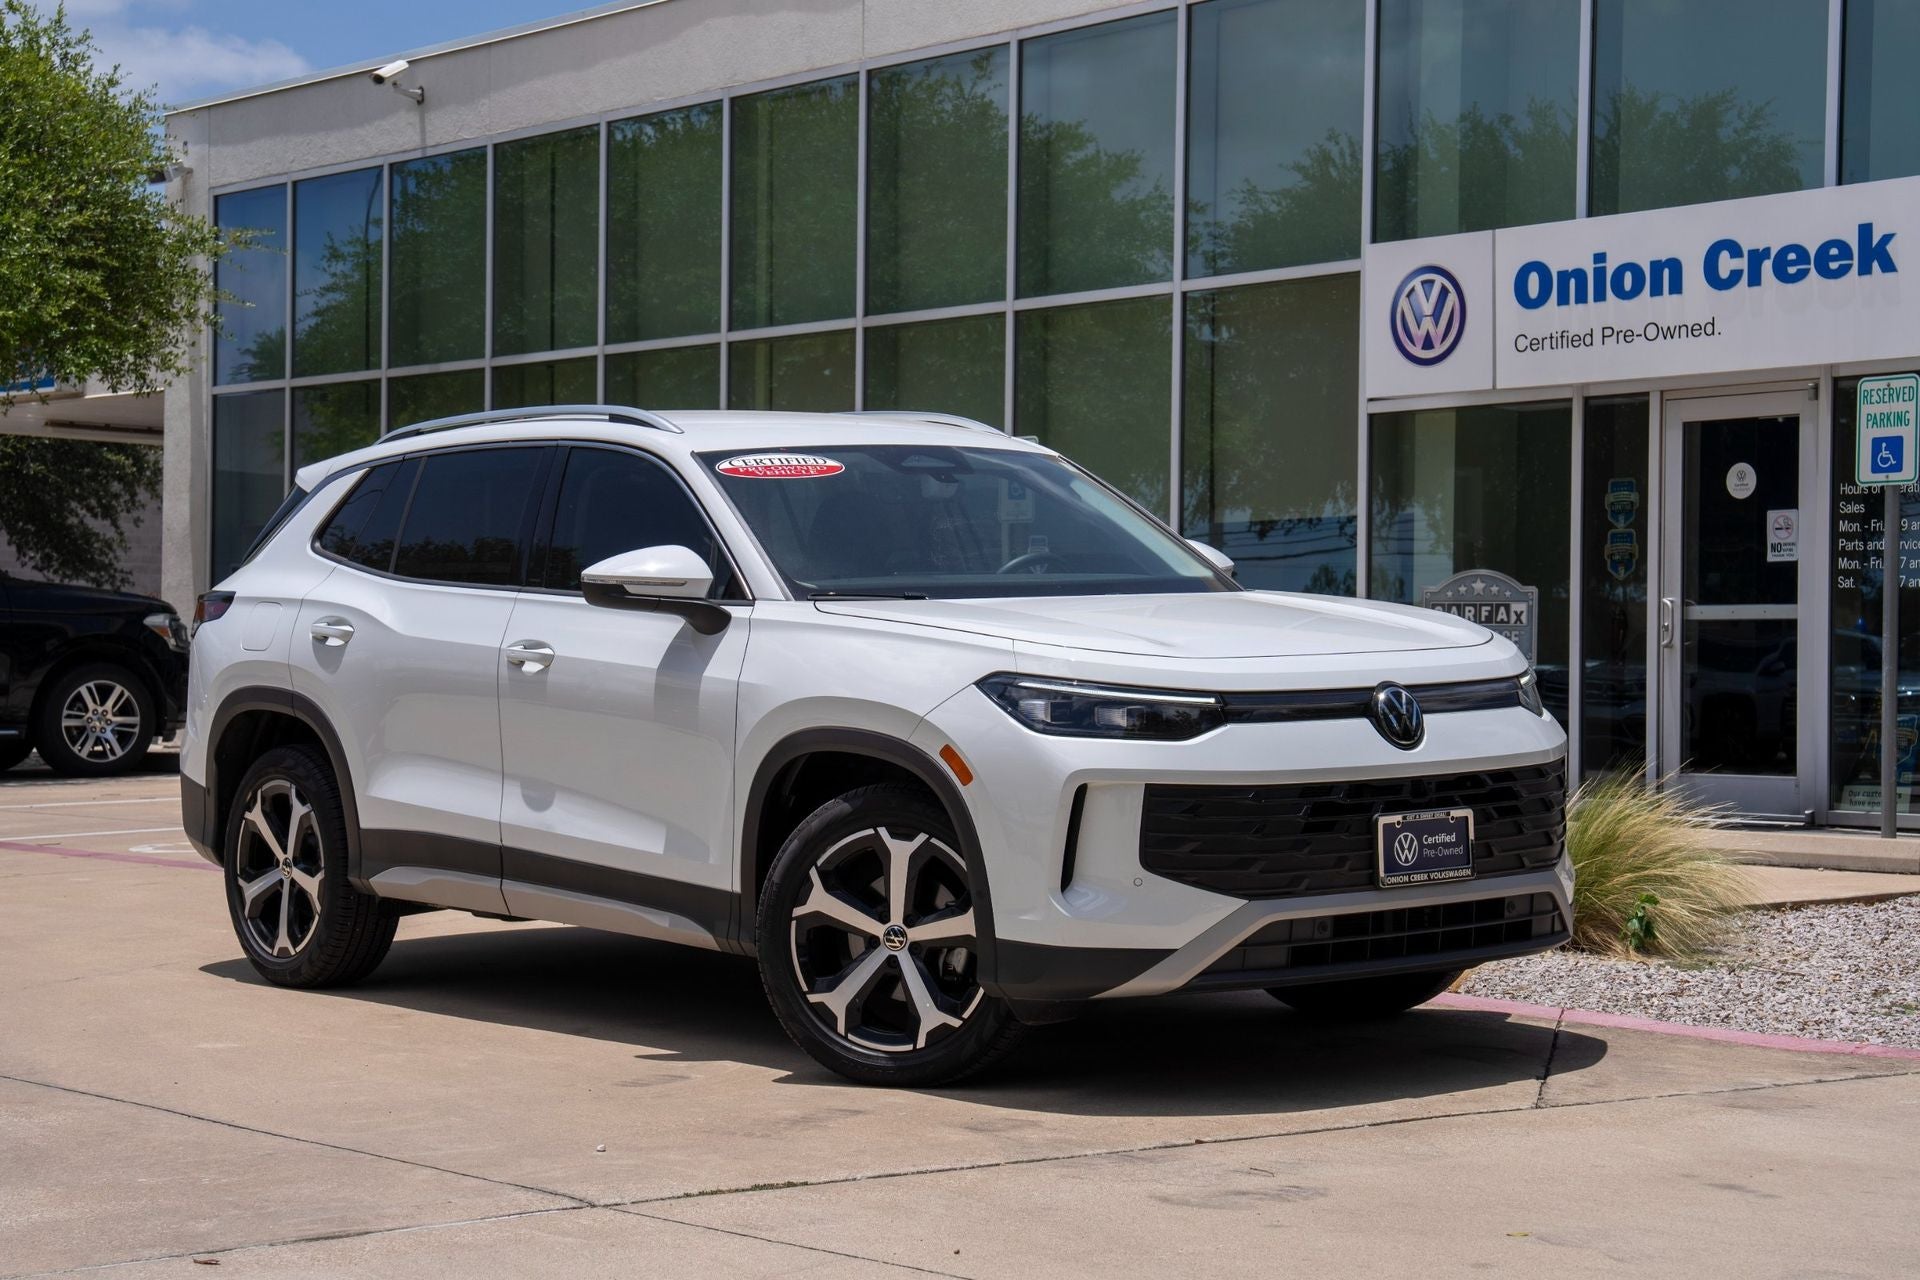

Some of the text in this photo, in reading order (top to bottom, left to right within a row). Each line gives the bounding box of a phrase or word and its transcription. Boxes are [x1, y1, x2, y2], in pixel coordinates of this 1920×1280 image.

[1513, 222, 1898, 311] Onion Creek
[1514, 316, 1722, 353] Certified Pre-Owned.
[1862, 385, 1915, 406] RESERVED
[1866, 410, 1910, 429] PARKING
[728, 456, 828, 467] CERTIFIED
[1840, 483, 1869, 495] Hours
[1839, 501, 1866, 514] Sales
[1839, 520, 1862, 532] Mon.
[1871, 519, 1885, 532] Fri.
[1901, 518, 1908, 531] 9
[1770, 542, 1783, 553] NO
[1839, 538, 1864, 551] Parts
[1866, 538, 1885, 551] and
[1838, 557, 1861, 569] Mon.
[1870, 557, 1885, 569] Fri.
[1900, 556, 1907, 569] 7
[1837, 576, 1856, 589] Sat.
[1899, 575, 1906, 588] 7
[1422, 832, 1456, 845] Certified
[1423, 845, 1464, 858] Pre-Owned
[1386, 868, 1472, 884] ONION CREEK VOLKSWAGEN
